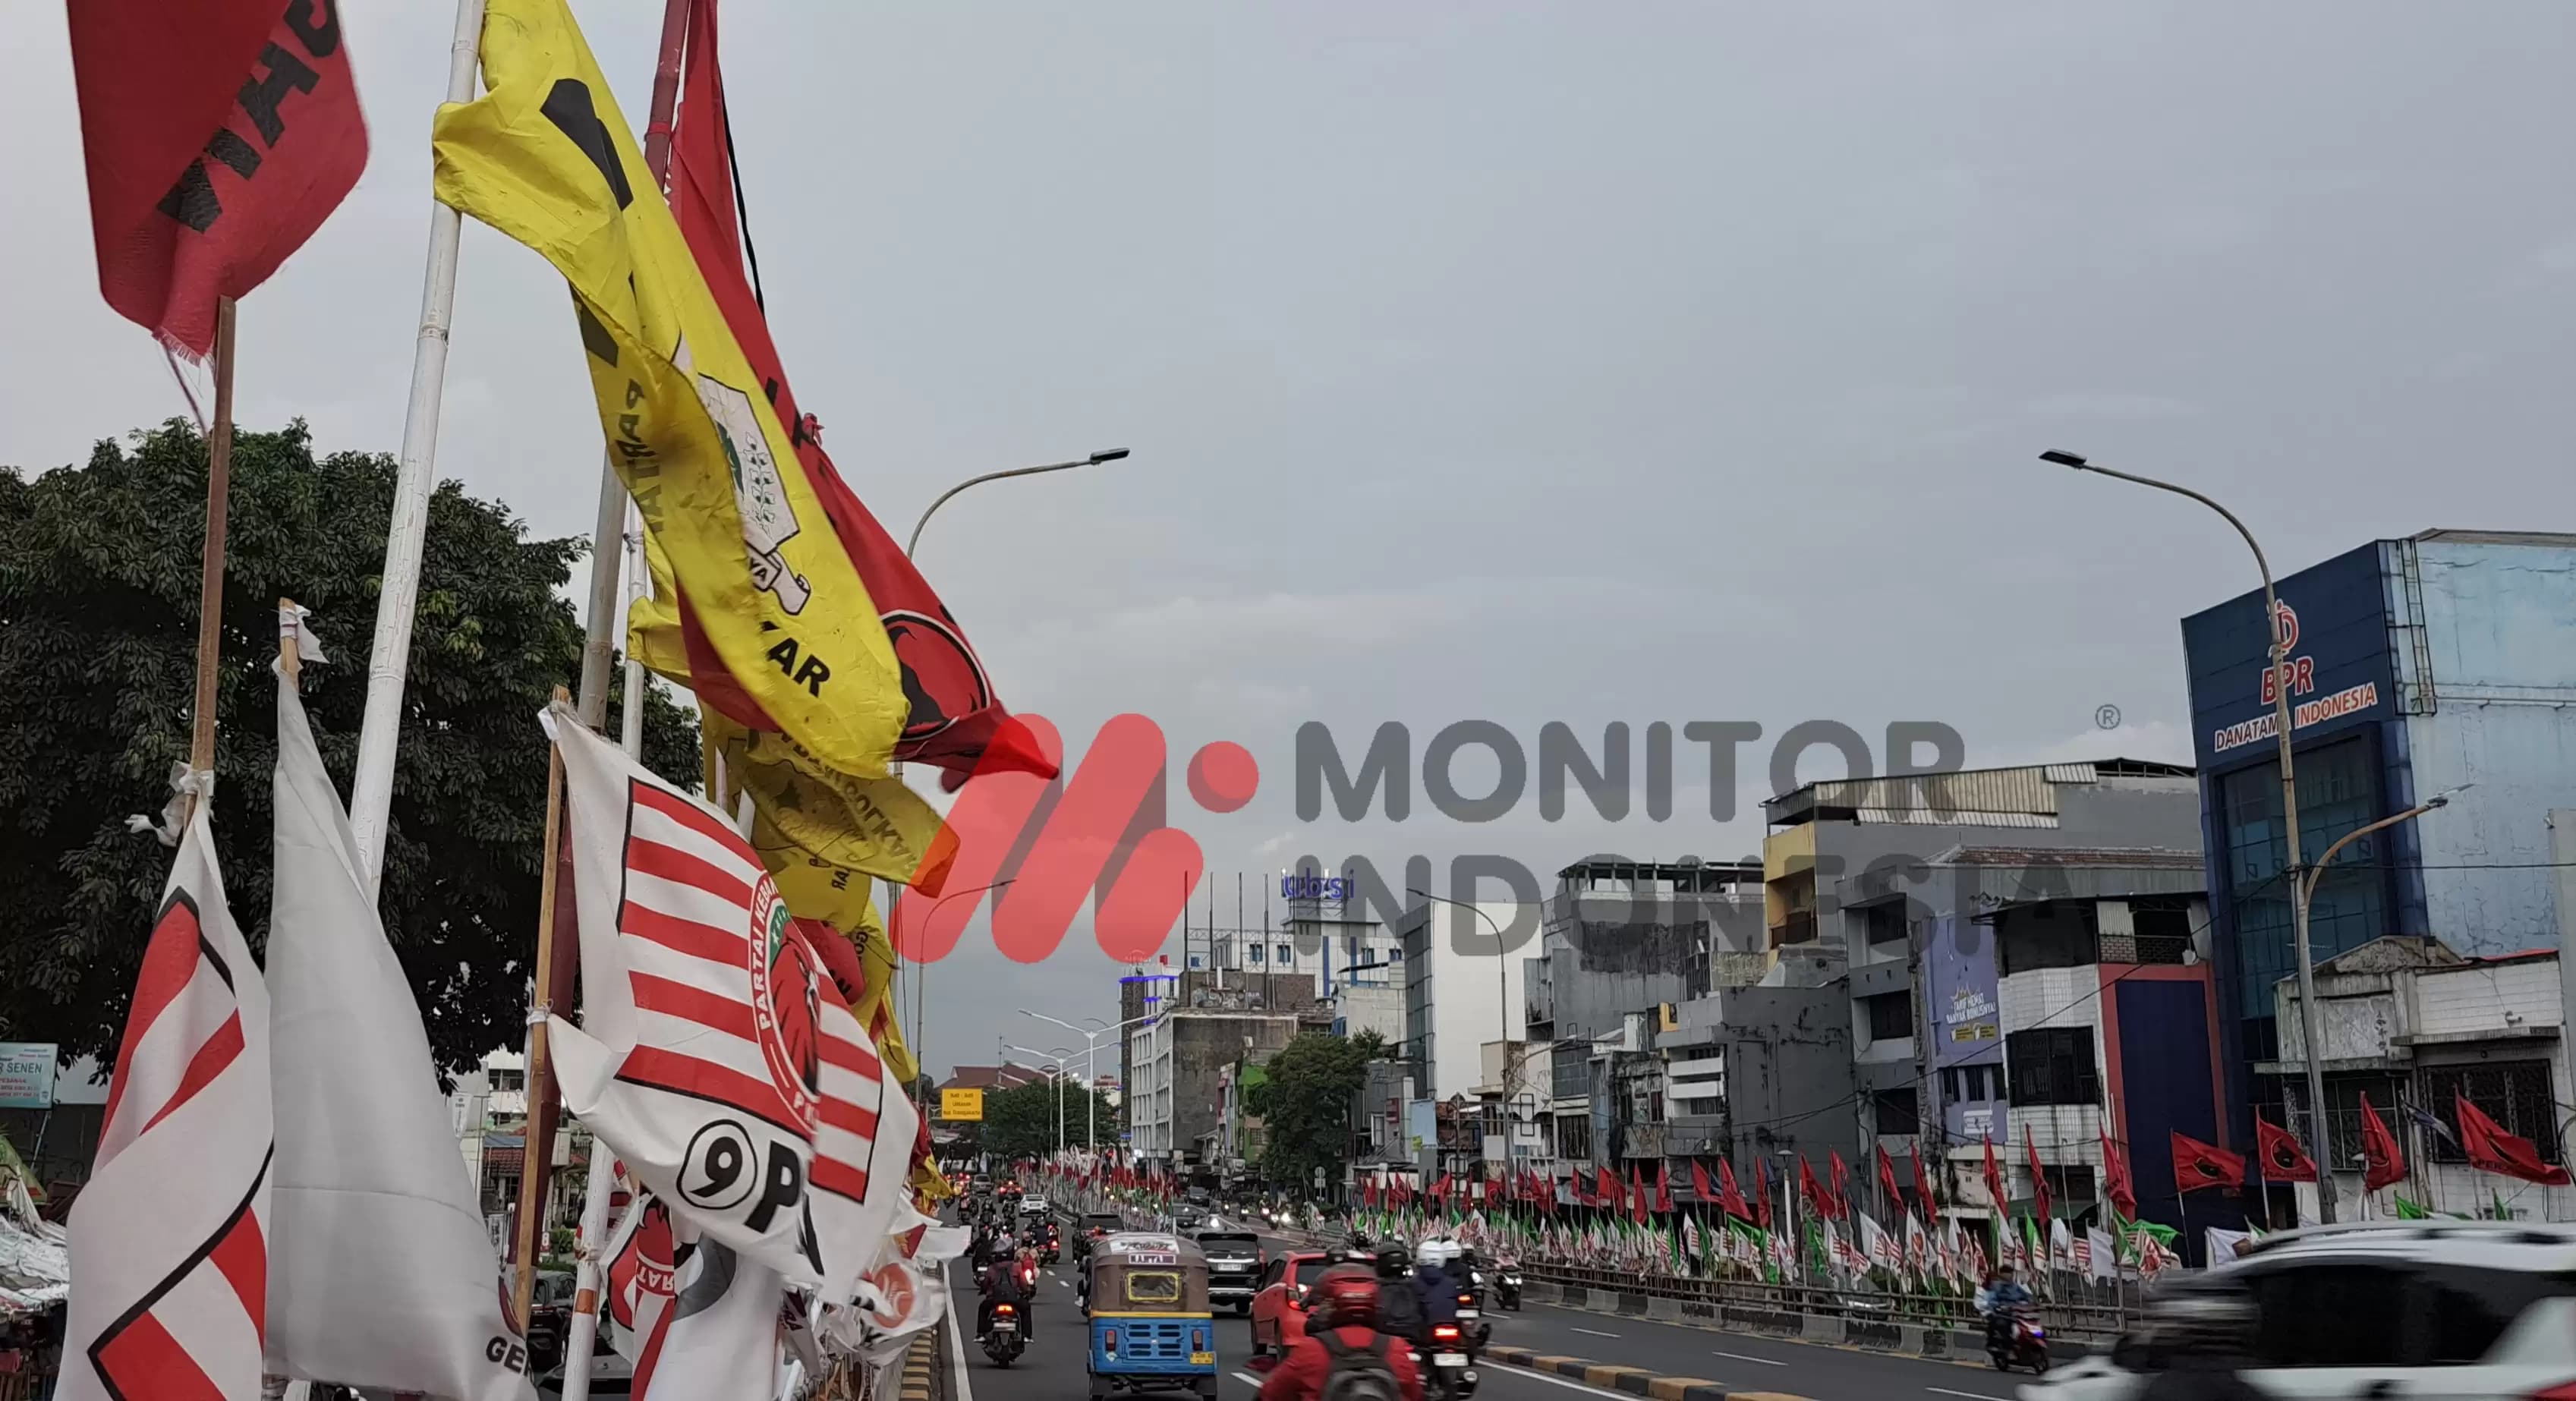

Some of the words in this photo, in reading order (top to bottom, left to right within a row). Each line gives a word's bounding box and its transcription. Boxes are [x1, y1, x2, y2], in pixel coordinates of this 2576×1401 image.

[761, 621, 830, 698] AR
[2215, 709, 2291, 753] DANATAM
[2294, 681, 2378, 729] INDONESIA
[1283, 867, 1355, 899] ubsi
[752, 926, 772, 1030] PARTAI
[7, 1063, 43, 1073] SENEN
[689, 1136, 743, 1198] 9
[486, 1336, 529, 1377] GE
